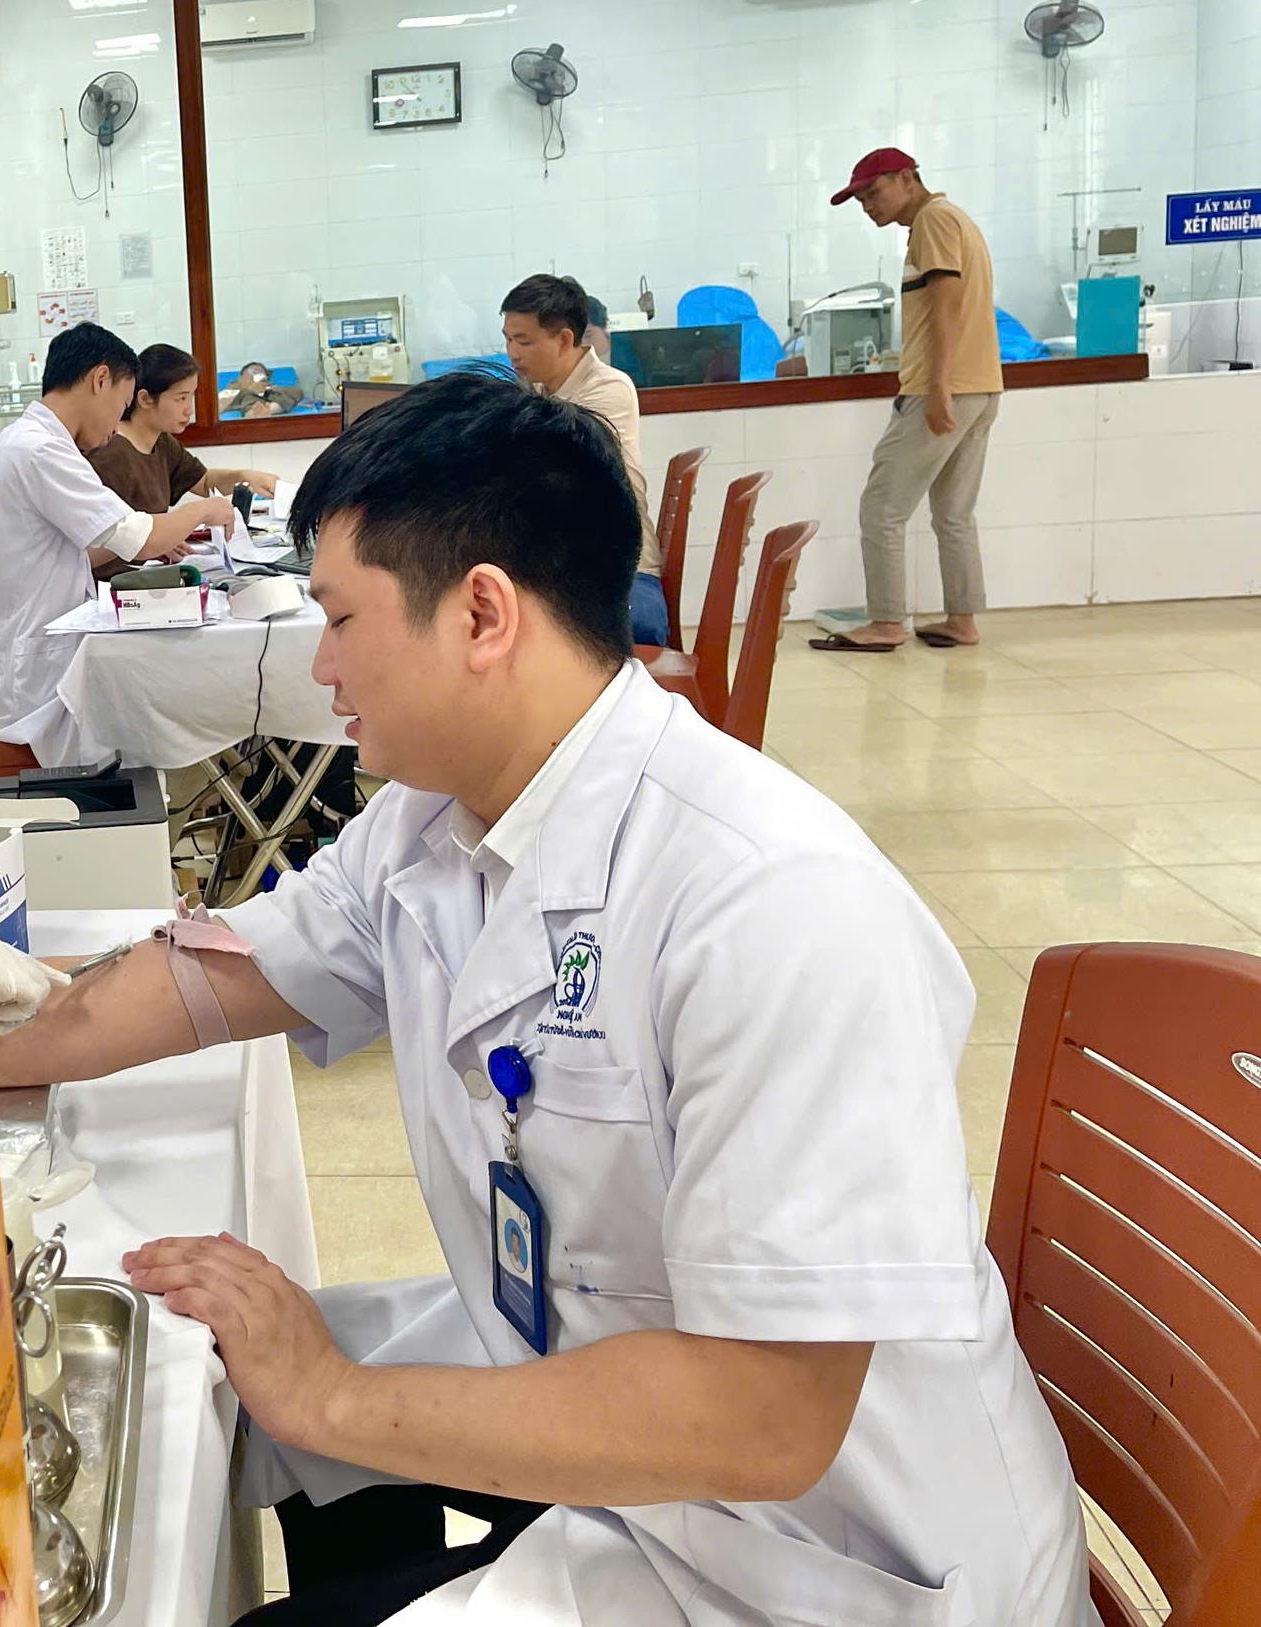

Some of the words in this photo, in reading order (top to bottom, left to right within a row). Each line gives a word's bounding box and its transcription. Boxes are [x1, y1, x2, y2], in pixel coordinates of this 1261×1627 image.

[1195, 198, 1220, 213] LẤY
[1184, 215, 1208, 234] XÉT
[1211, 211, 1261, 233] NGHIỆM
